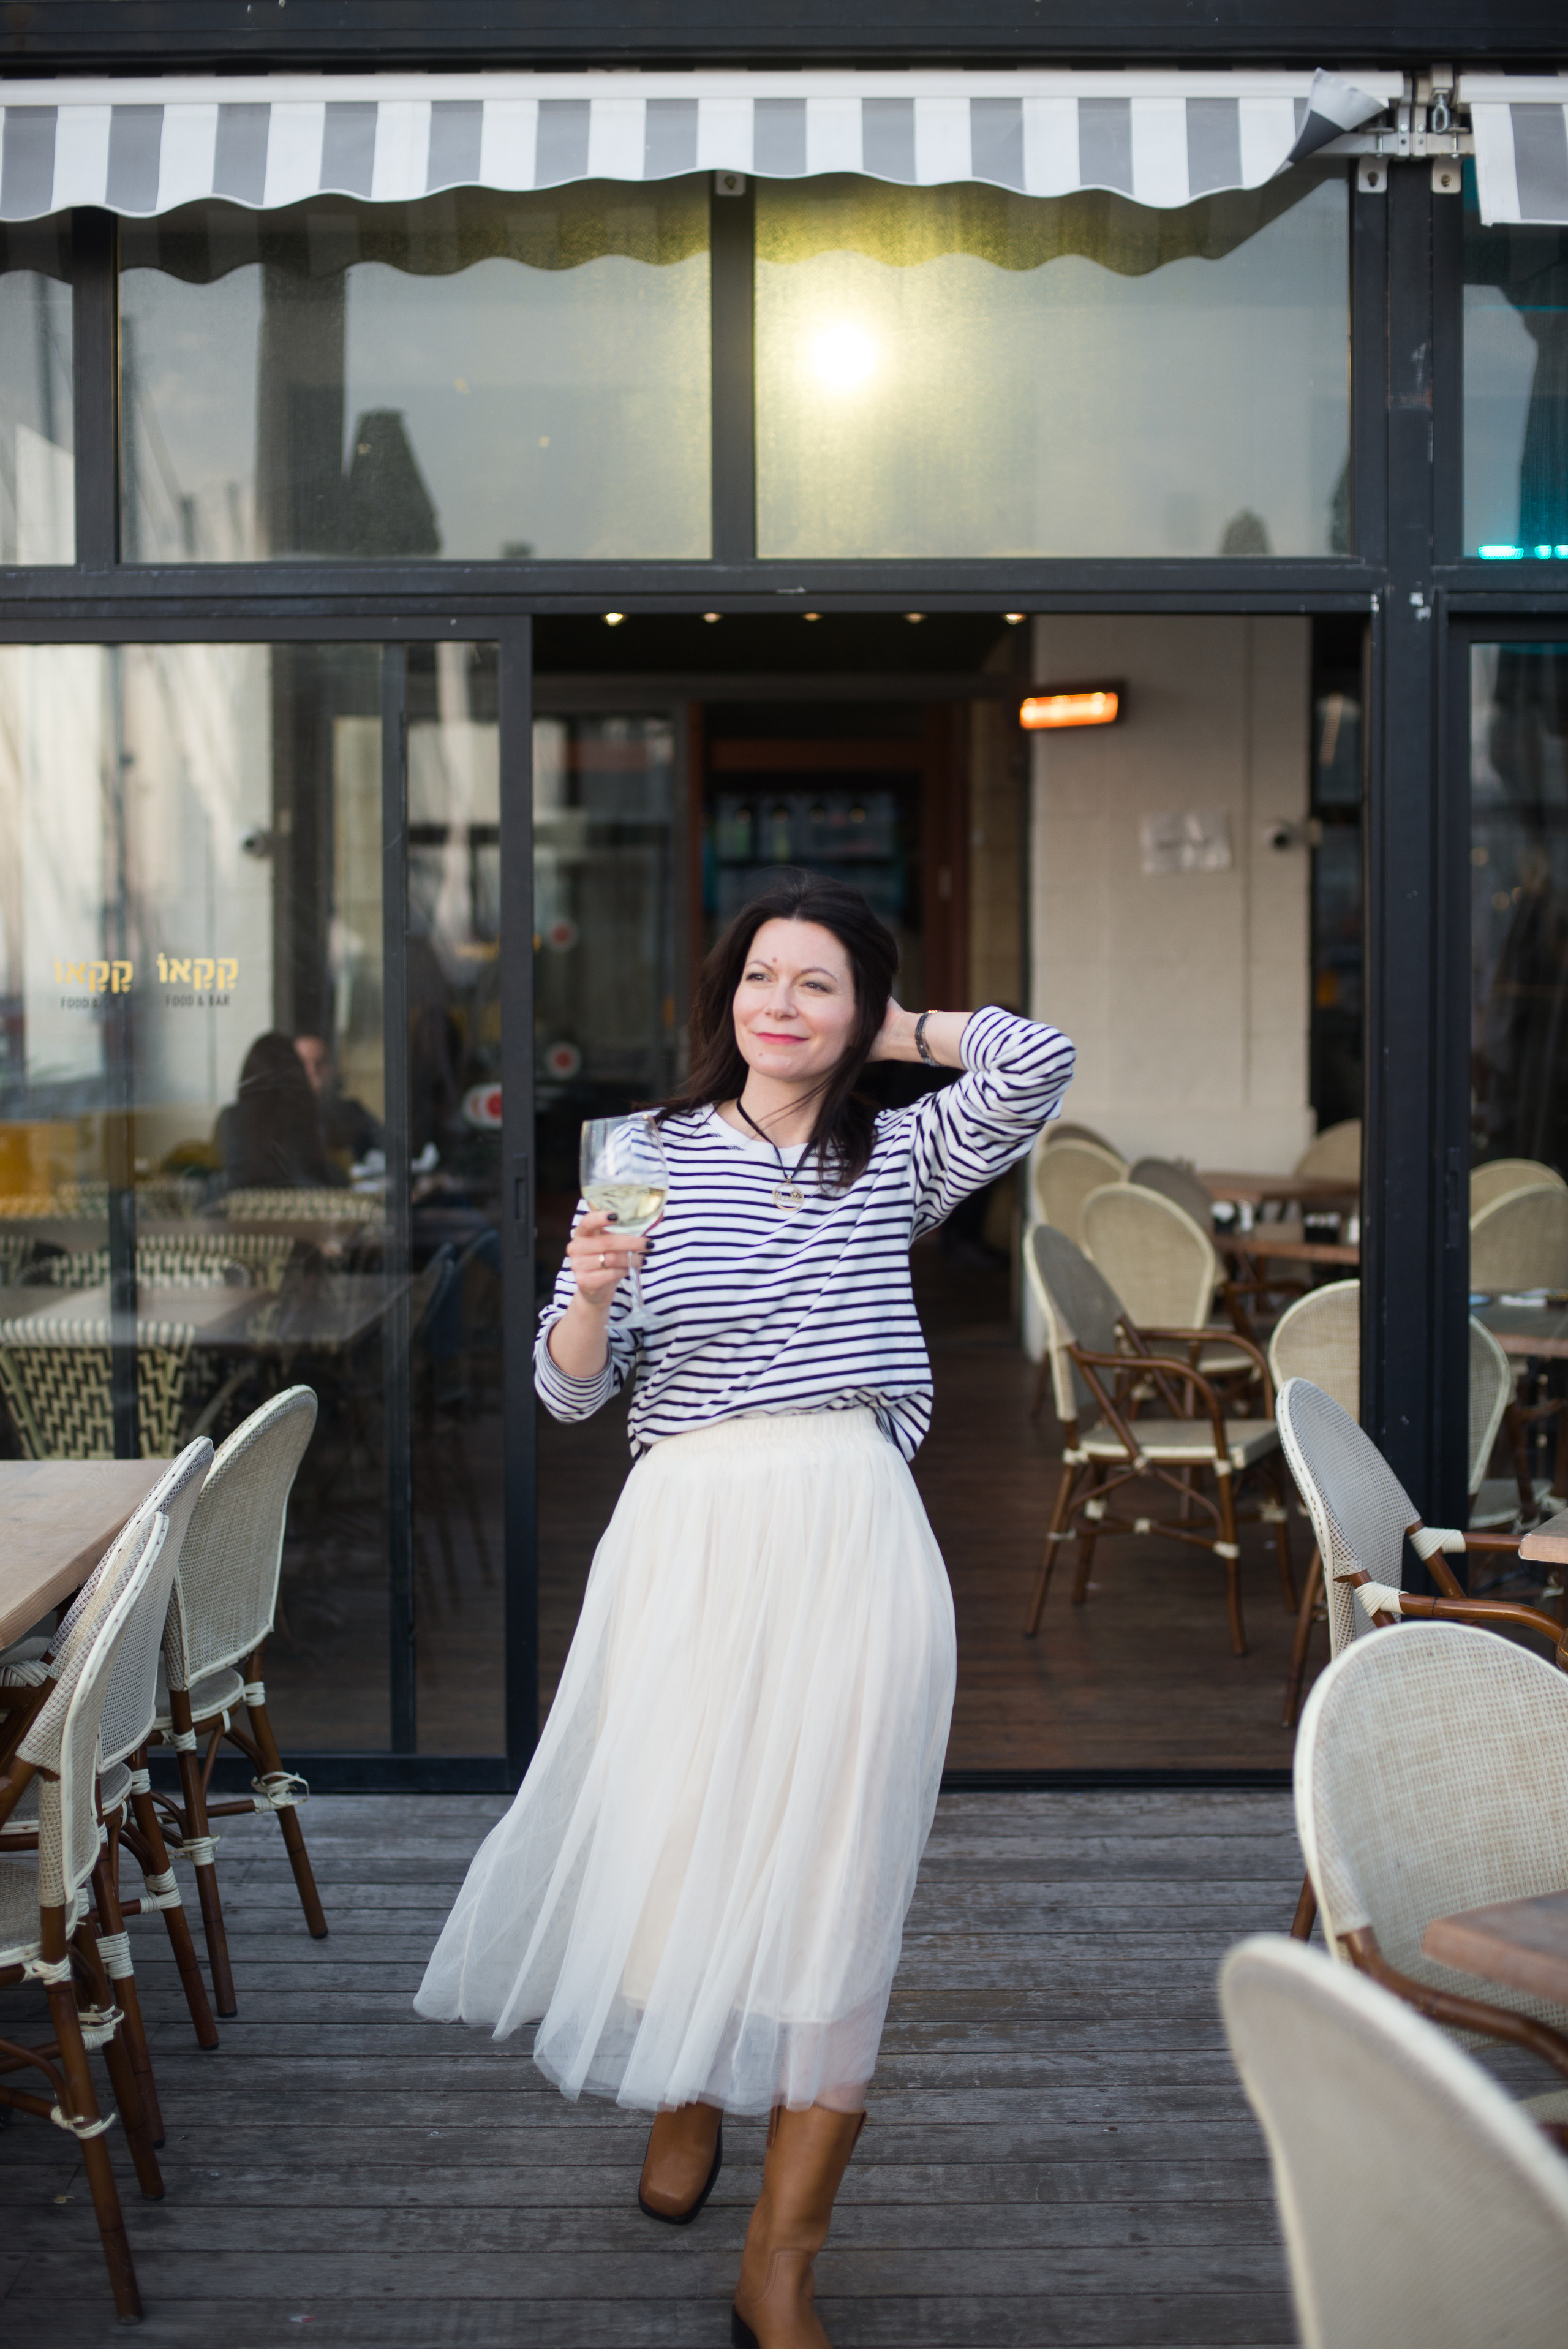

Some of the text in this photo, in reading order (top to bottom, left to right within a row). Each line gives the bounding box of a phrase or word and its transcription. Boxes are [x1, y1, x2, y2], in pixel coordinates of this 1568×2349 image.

[61, 996, 89, 1008] FOOD
[165, 994, 230, 1007] FOOD & BAR
